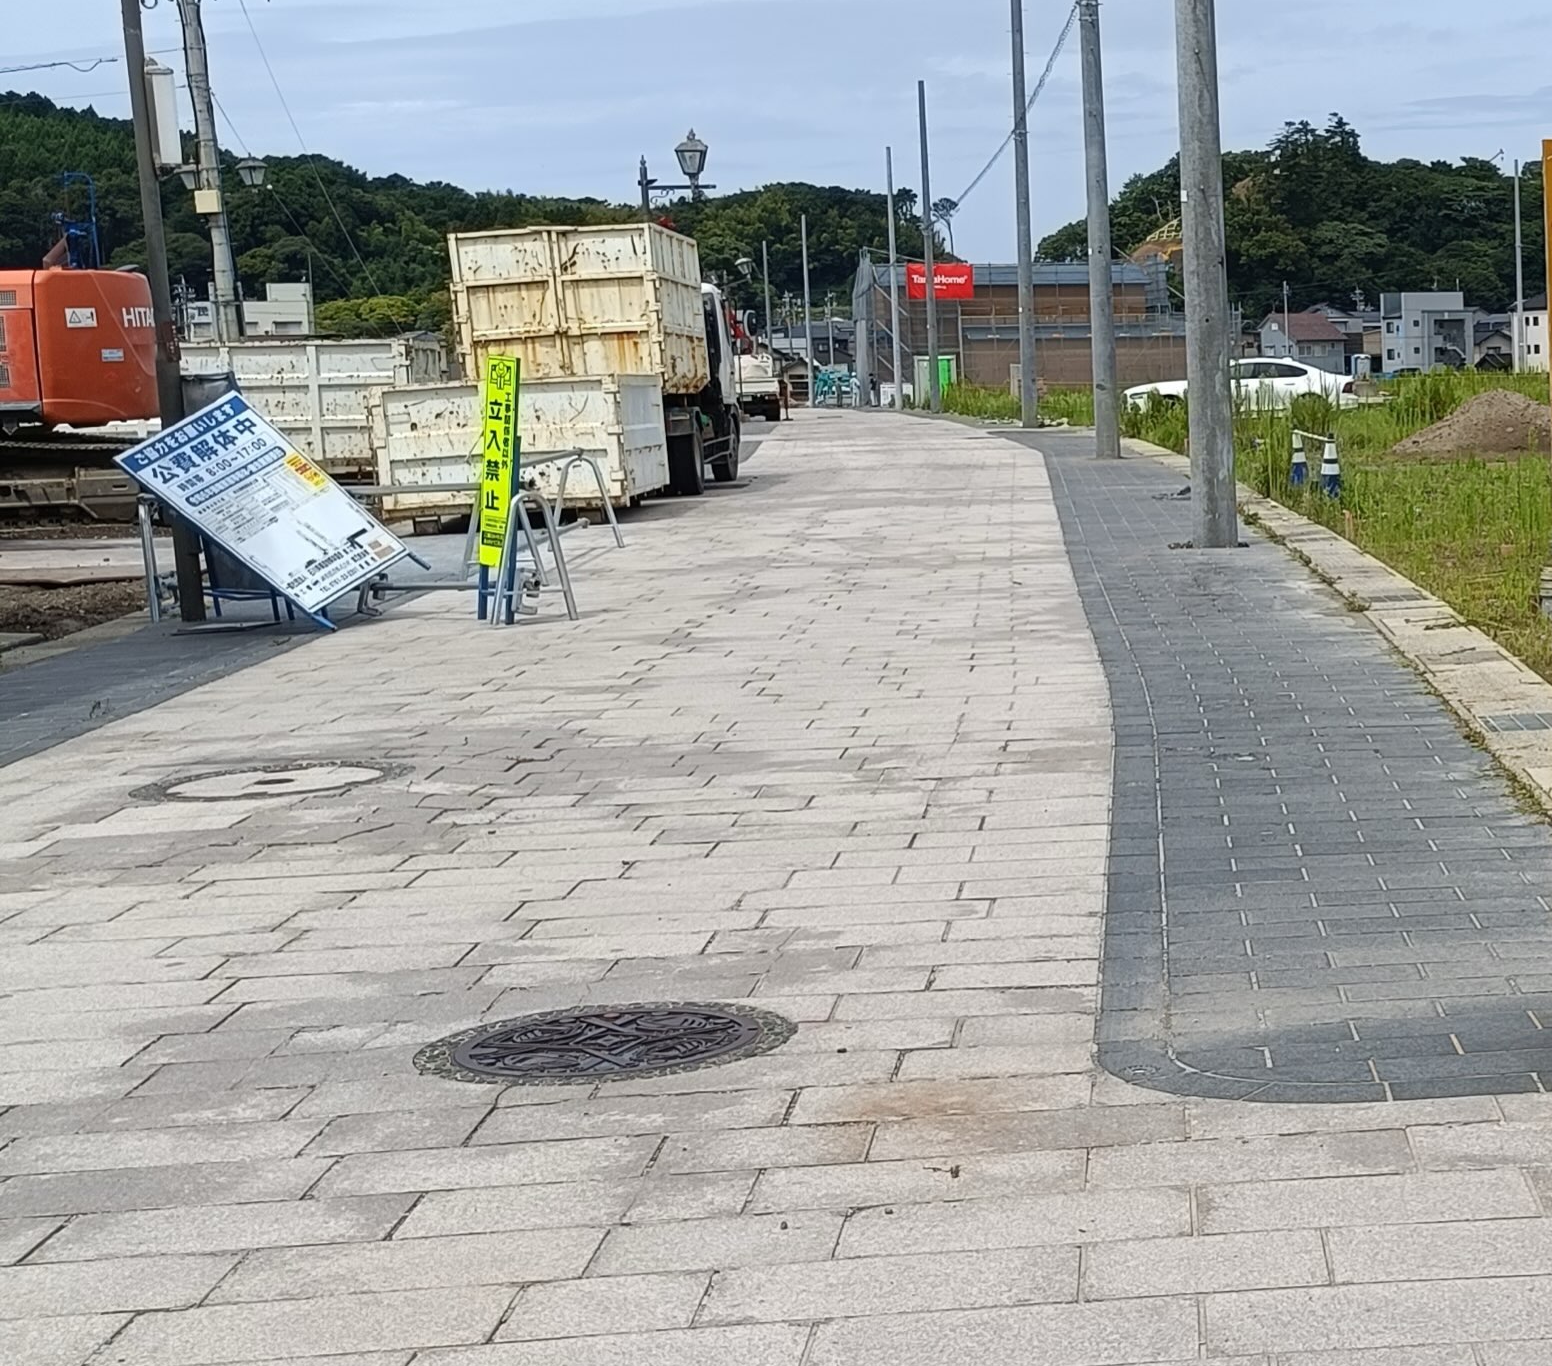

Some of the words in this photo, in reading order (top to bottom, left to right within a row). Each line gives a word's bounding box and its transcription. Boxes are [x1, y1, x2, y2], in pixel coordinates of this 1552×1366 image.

[122, 307, 156, 328] HITA
[134, 403, 236, 466] ご協力をお願いします
[151, 417, 258, 484] 公費解体中
[485, 399, 503, 511] 立入禁止
